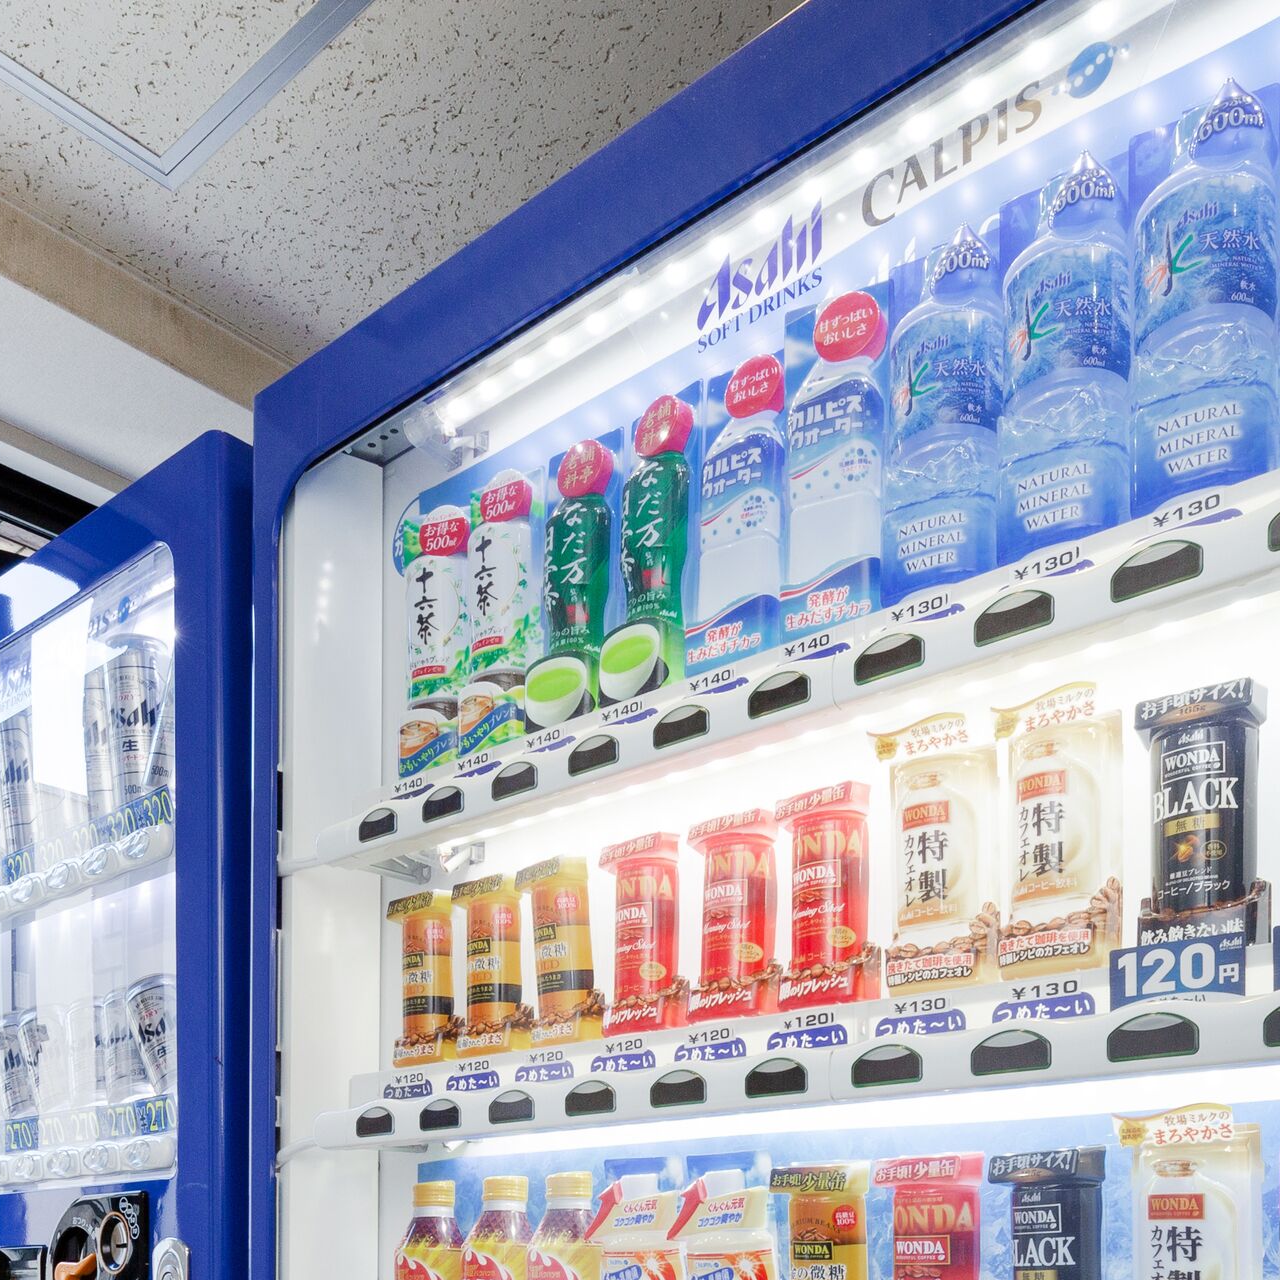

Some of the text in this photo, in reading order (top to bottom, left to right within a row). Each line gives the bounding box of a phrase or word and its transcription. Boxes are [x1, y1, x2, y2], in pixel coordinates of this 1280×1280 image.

[861, 80, 1043, 227] CALPIS
[1200, 230, 1260, 252] 天然水
[697, 198, 822, 331] Asahi
[698, 267, 822, 353] SOFT DRINKS
[1055, 296, 1112, 318] 天然水
[820, 307, 873, 334] 甘ずっぱい
[823, 322, 867, 347] おいしさ
[733, 380, 769, 404] おいしさ
[789, 394, 863, 431] カルピス
[1156, 403, 1242, 436] NATURAL
[1157, 425, 1240, 459] MINERAL
[703, 446, 762, 485] カルピス
[1166, 447, 1228, 476] WATER
[485, 484, 519, 504] お得な
[635, 461, 664, 548] なだ万
[1152, 494, 1222, 527] ¥130
[424, 521, 459, 537] お得な
[560, 502, 587, 585] なだ万
[474, 535, 499, 617] 十六茶
[414, 566, 441, 645] 十六茶
[808, 586, 849, 609] 発酵が
[786, 600, 870, 631] 生みだすチカラ
[706, 621, 743, 644] 発酵が
[687, 633, 762, 665] 生みだすチカラ
[784, 633, 830, 657] ¥140
[689, 668, 731, 692] ¥140
[526, 729, 561, 749] ¥140
[1165, 748, 1221, 772] WONDA
[1153, 777, 1239, 824] BLACK
[1011, 979, 1078, 999] ¥130
[605, 1038, 643, 1054] ¥120
[688, 1027, 731, 1045] ¥120
[529, 1050, 564, 1064] ¥120
[107, 1106, 137, 1137] 270
[1153, 1123, 1234, 1146] まろやかさ
[875, 1160, 957, 1183] お手頃!少量缶
[992, 1151, 1074, 1177] お手頃サイズ!
[771, 1170, 848, 1193] お手頃!少量缶
[707, 1197, 745, 1214] ぐんぐん元気
[1150, 1197, 1200, 1212] WONDA
[697, 1211, 744, 1229] ゴクゴク爽やか
